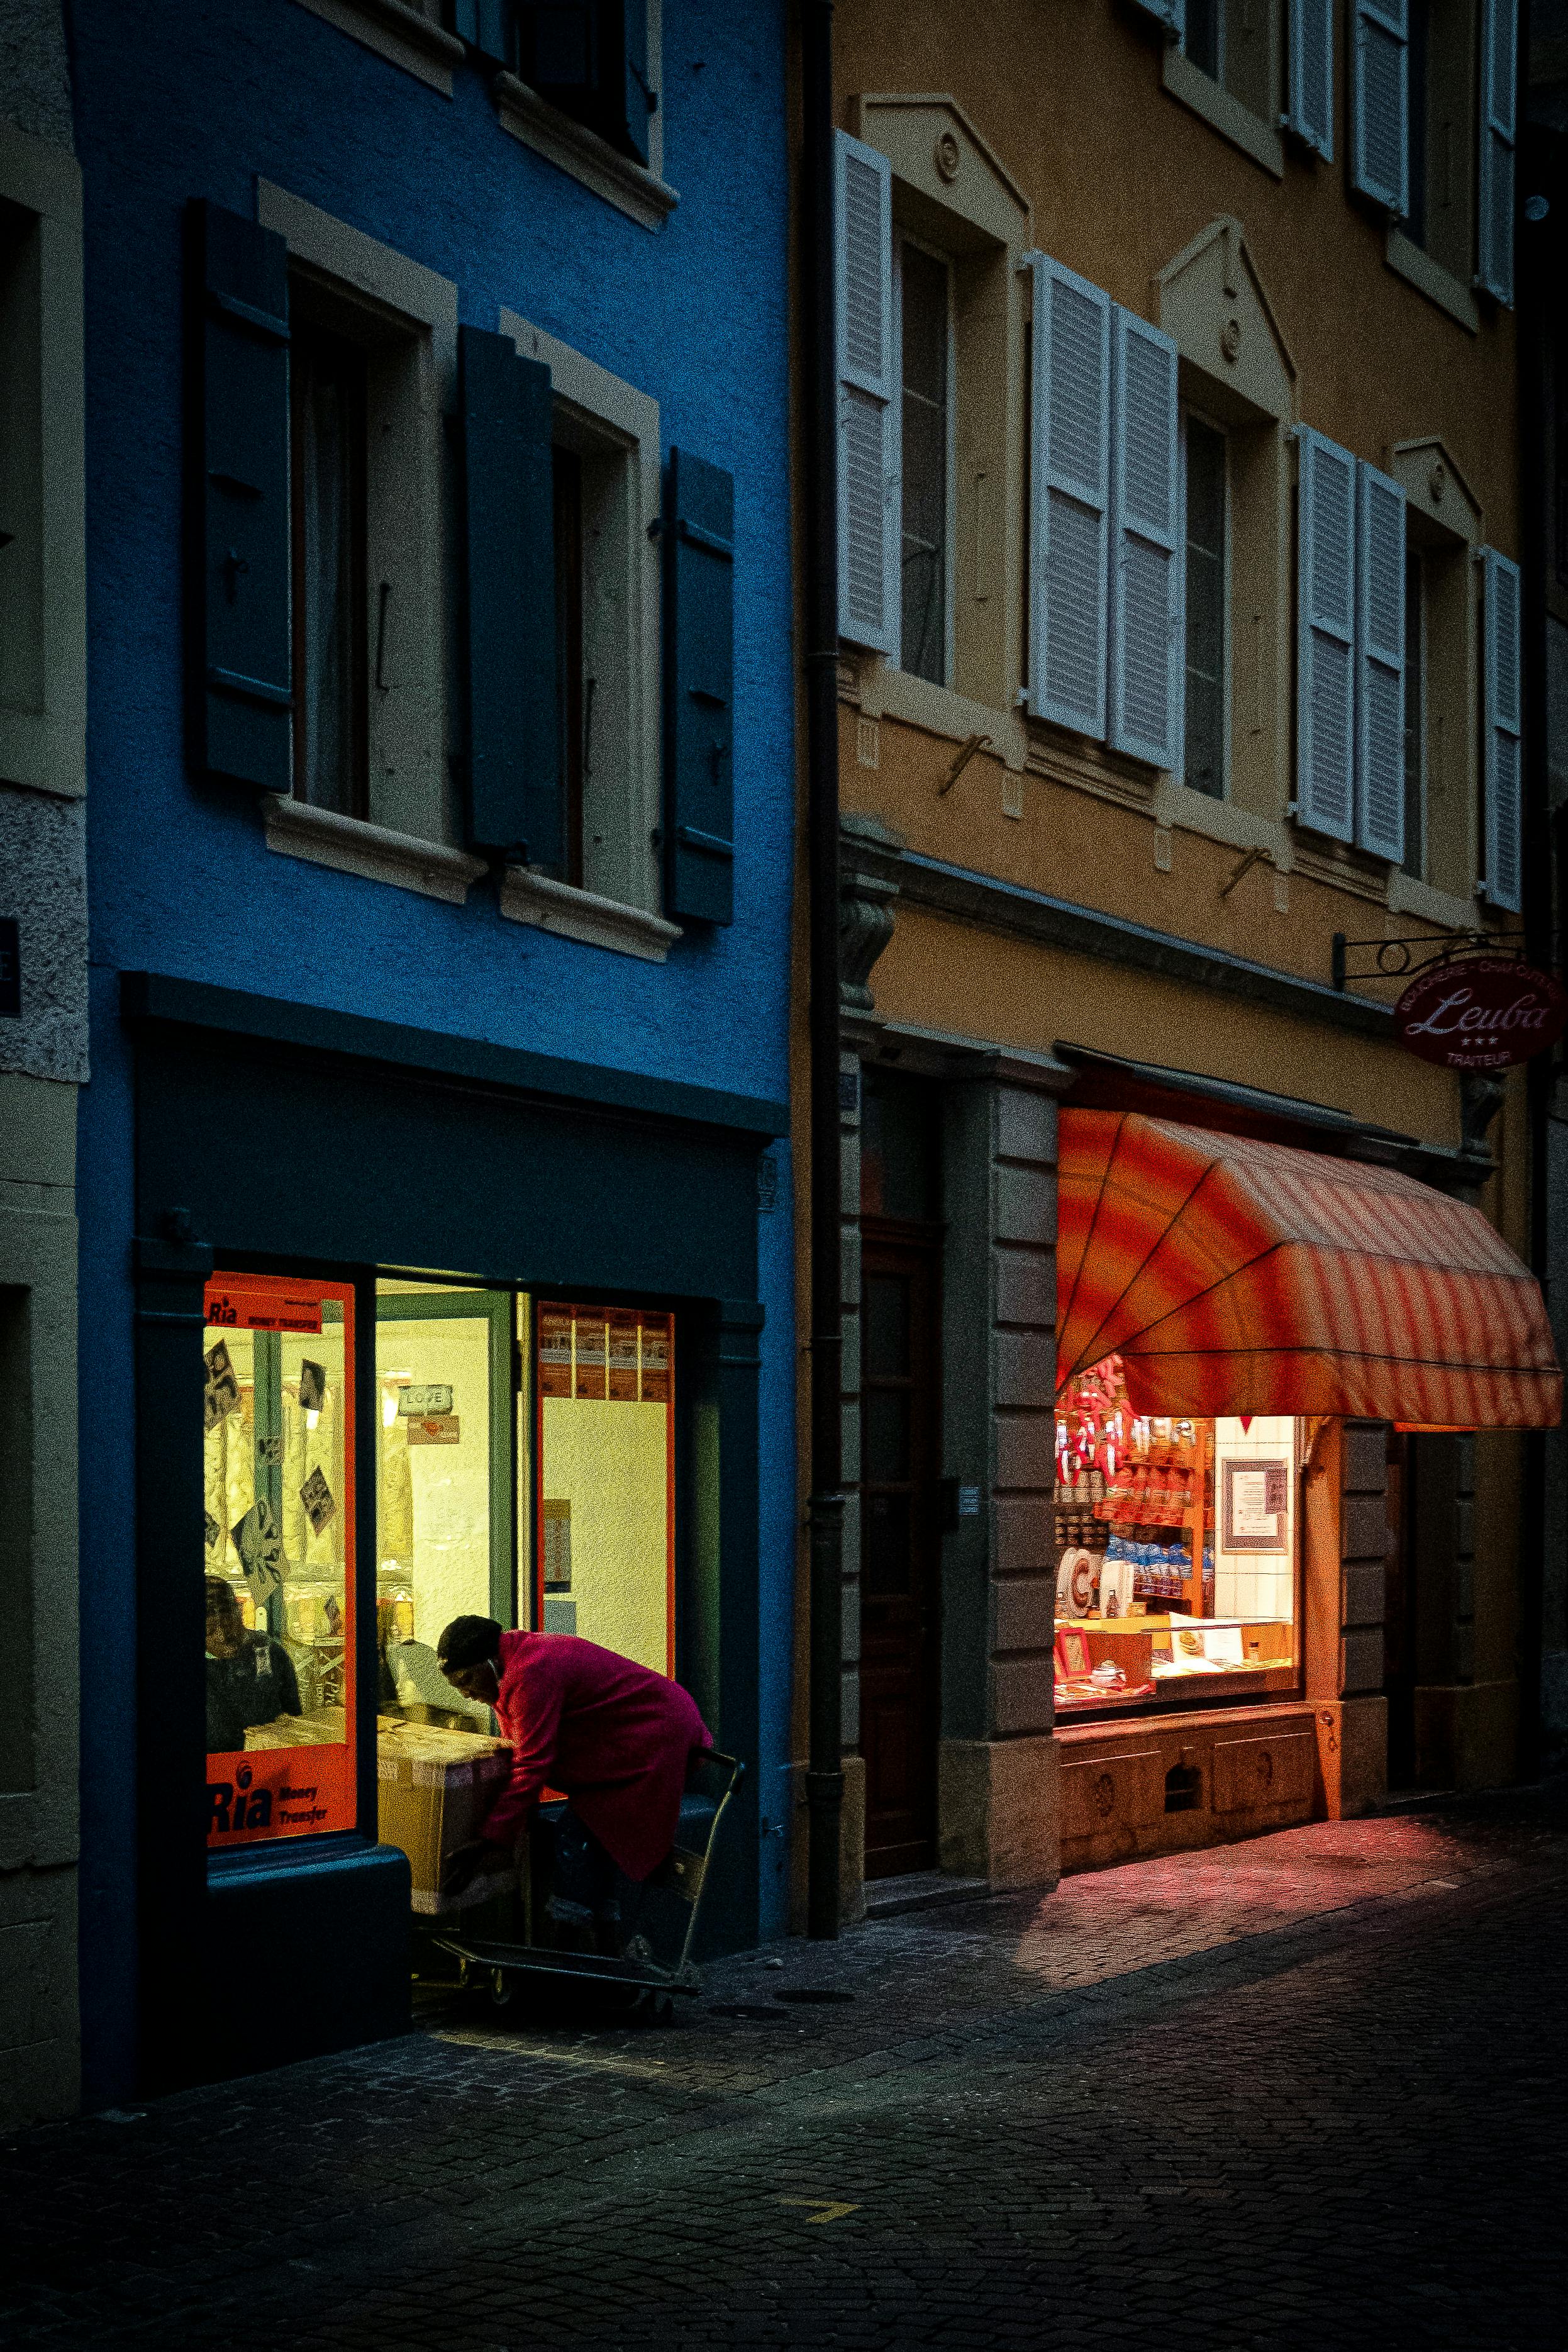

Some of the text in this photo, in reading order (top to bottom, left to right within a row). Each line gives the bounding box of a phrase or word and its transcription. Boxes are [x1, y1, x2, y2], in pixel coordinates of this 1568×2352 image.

[1400, 964, 1467, 1012] BOUCHERIE
[1404, 988, 1551, 1035] Leuba
[1447, 1051, 1512, 1067] TRAITEUR
[209, 1296, 237, 1324] Ria
[407, 1392, 443, 1403] LOVE
[206, 1760, 271, 1832] Ria
[280, 1787, 318, 1801] Money
[280, 1807, 327, 1824] Transfer
